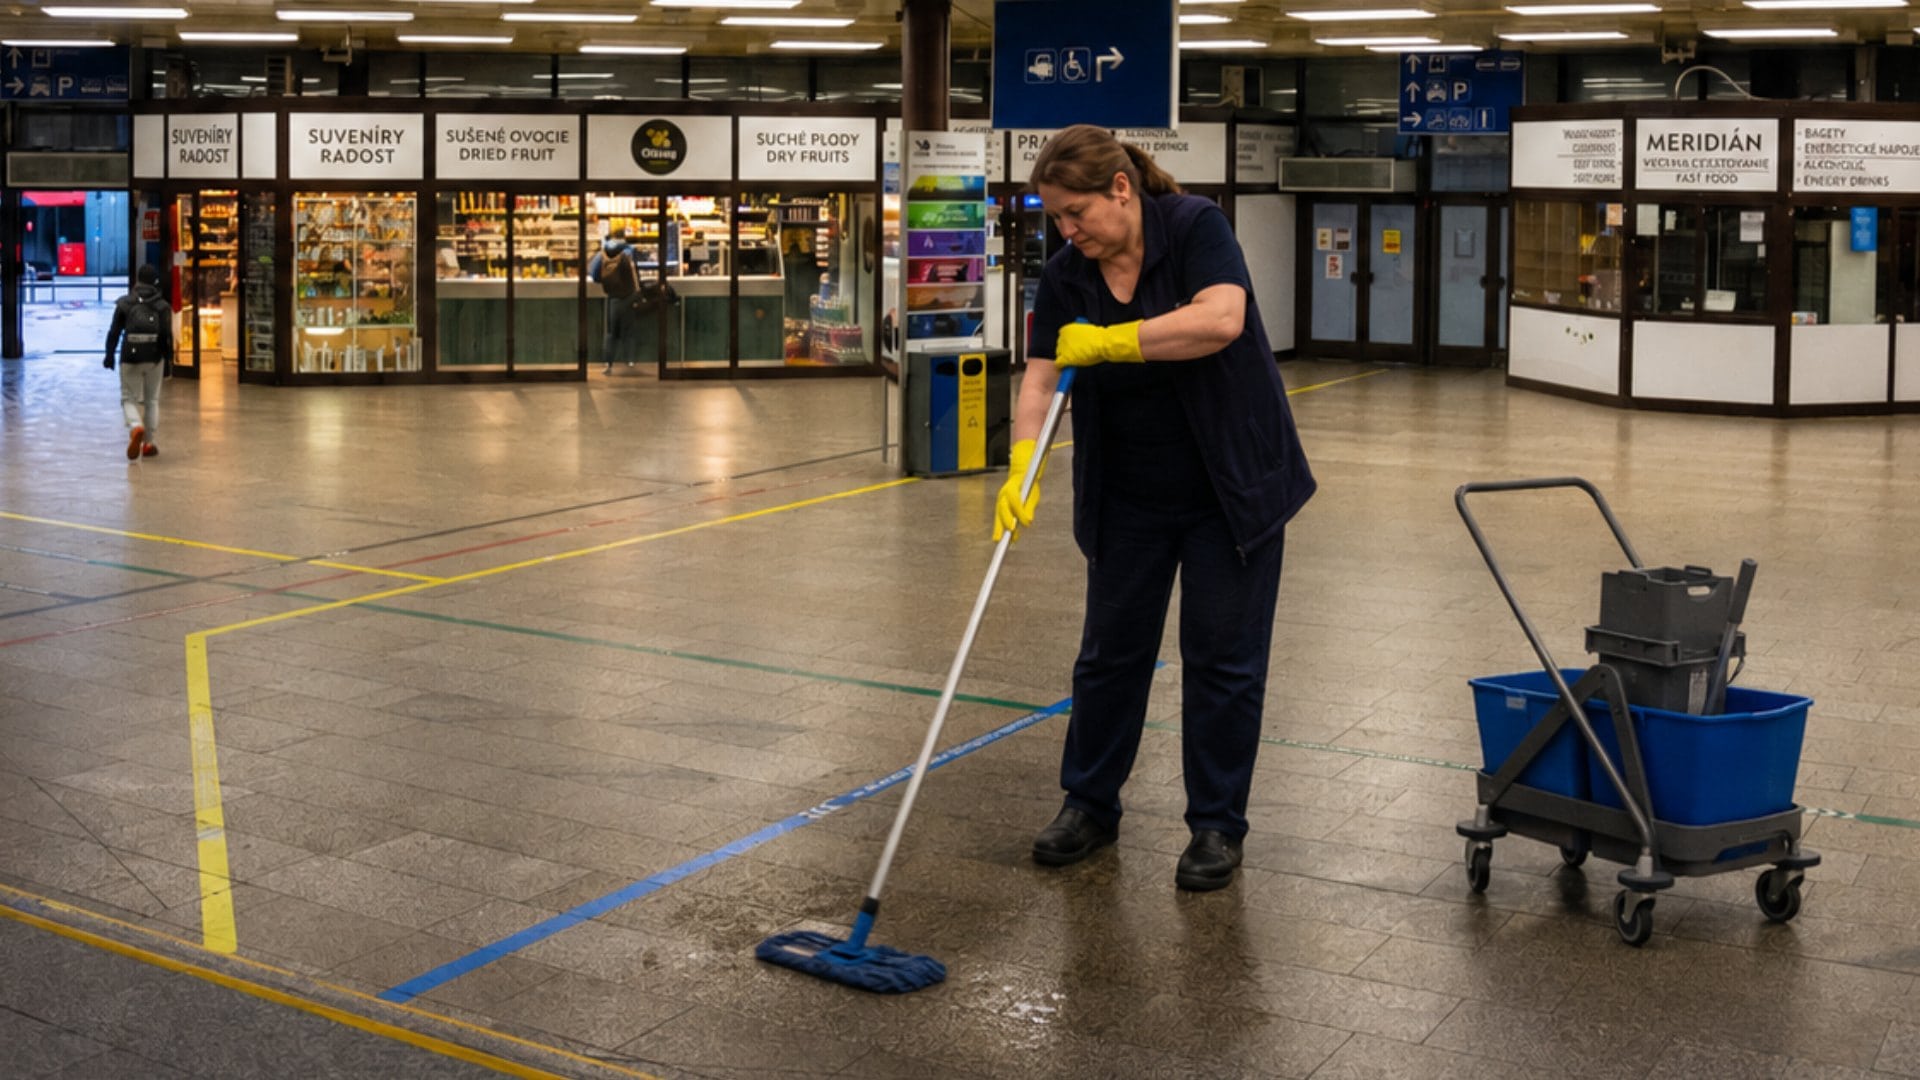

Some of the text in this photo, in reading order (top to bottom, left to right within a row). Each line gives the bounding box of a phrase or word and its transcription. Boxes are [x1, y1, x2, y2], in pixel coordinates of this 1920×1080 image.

[58, 77, 74, 96] P
[1453, 82, 1467, 100] P
[172, 124, 232, 144] SUVENÍRY
[308, 125, 405, 144] SUVENÍRY
[446, 126, 569, 143] SUŠENÉ OVOCIE
[811, 133, 859, 146] PLODY
[1647, 127, 1762, 151] MERIDIÁN
[1805, 128, 1846, 138] BAGETY
[180, 148, 229, 163] RADOST
[321, 148, 395, 163] RADOST
[459, 148, 555, 160] DRIED FRUIT
[767, 150, 849, 163] DRY FRUITS
[1676, 173, 1738, 184] FAST FOOD
